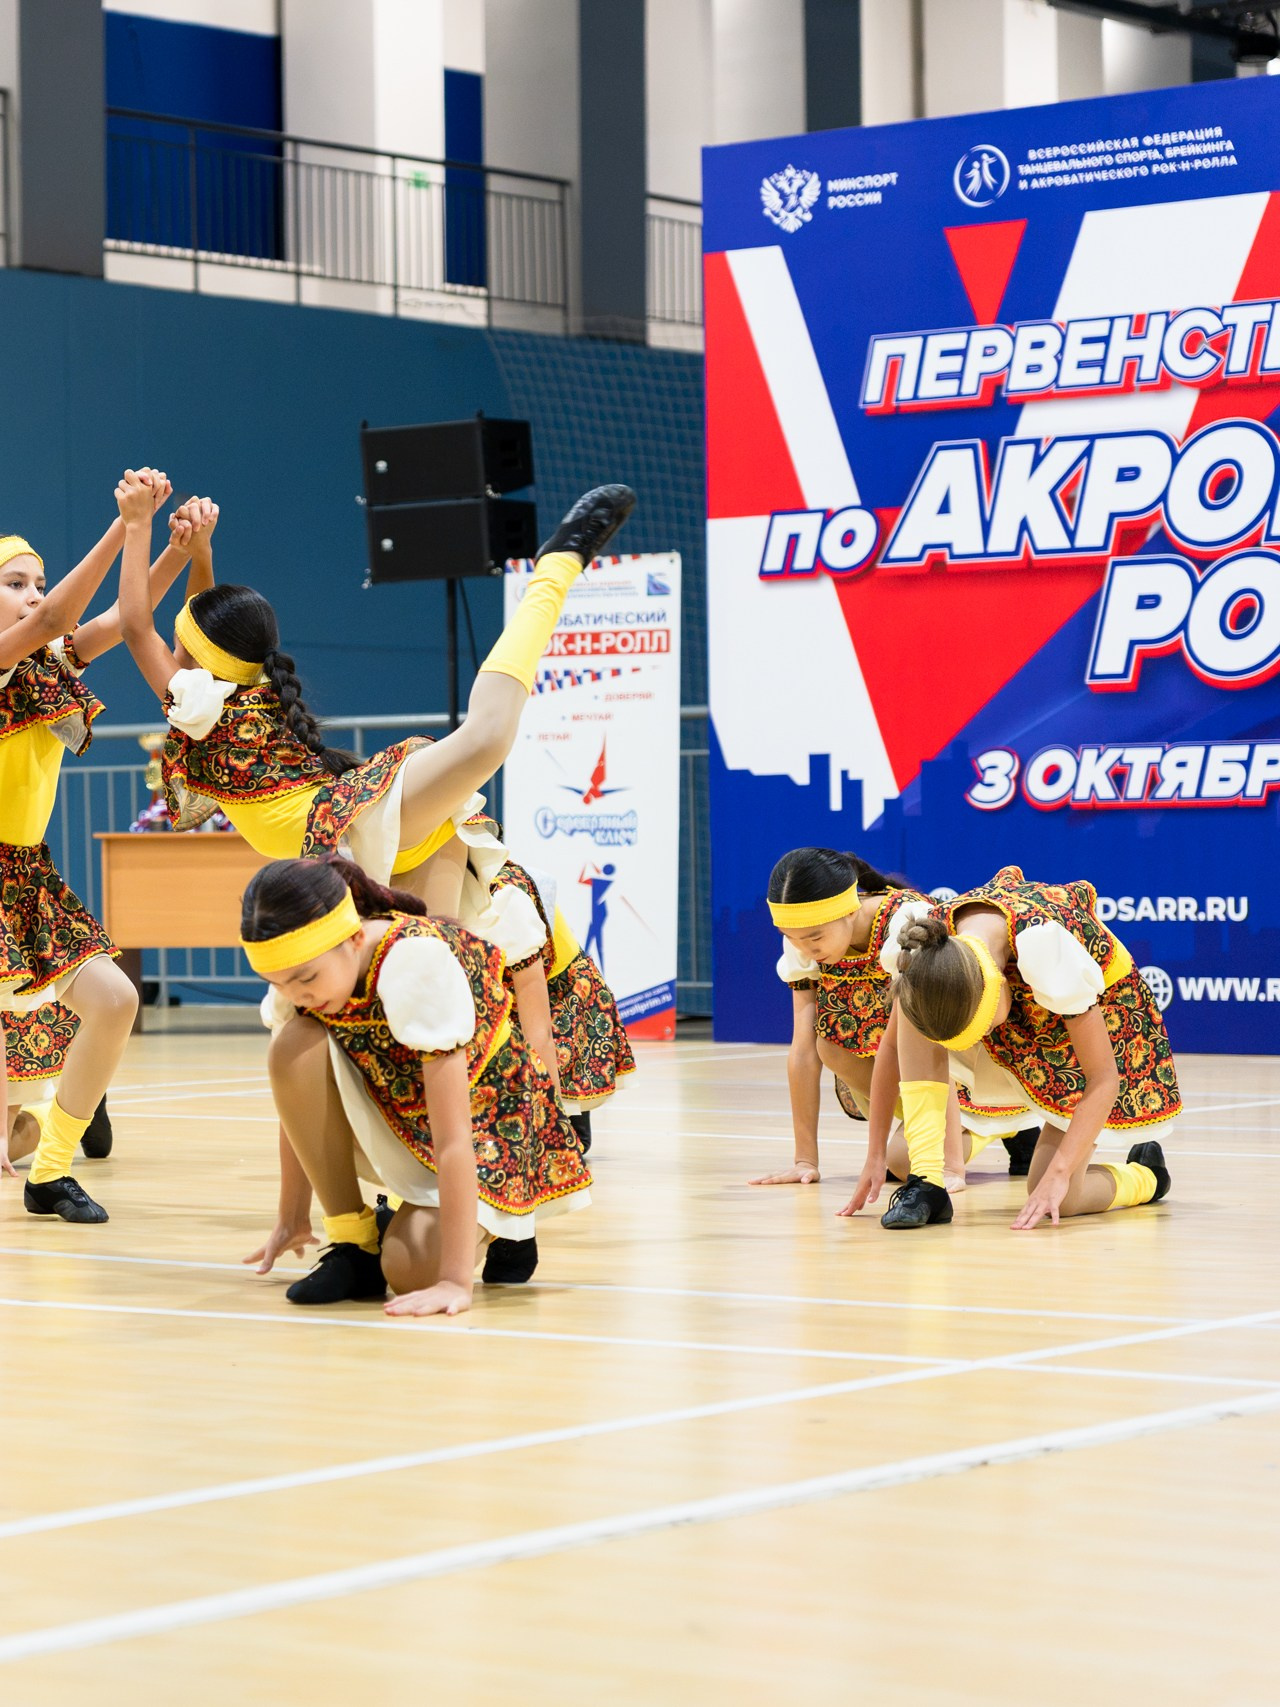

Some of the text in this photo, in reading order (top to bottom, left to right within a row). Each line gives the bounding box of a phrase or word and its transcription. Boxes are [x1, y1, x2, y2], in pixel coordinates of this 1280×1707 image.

[1017, 154, 1114, 176] ТАНЦЕВАЛЬНОГО
[1165, 140, 1235, 159] БРЕЙКИНГА
[1027, 126, 1223, 161] ВСЕРОССИЙСКАЯ ФЕДЕРАЦИЯ
[827, 172, 899, 193] МИНСПОРТ
[1018, 179, 1029, 191] И
[1030, 165, 1149, 189] АКРОБАТИЧЕСКОГО
[827, 191, 883, 210] РОССИИ
[880, 420, 1280, 566] АКРО
[966, 747, 1020, 809] 3
